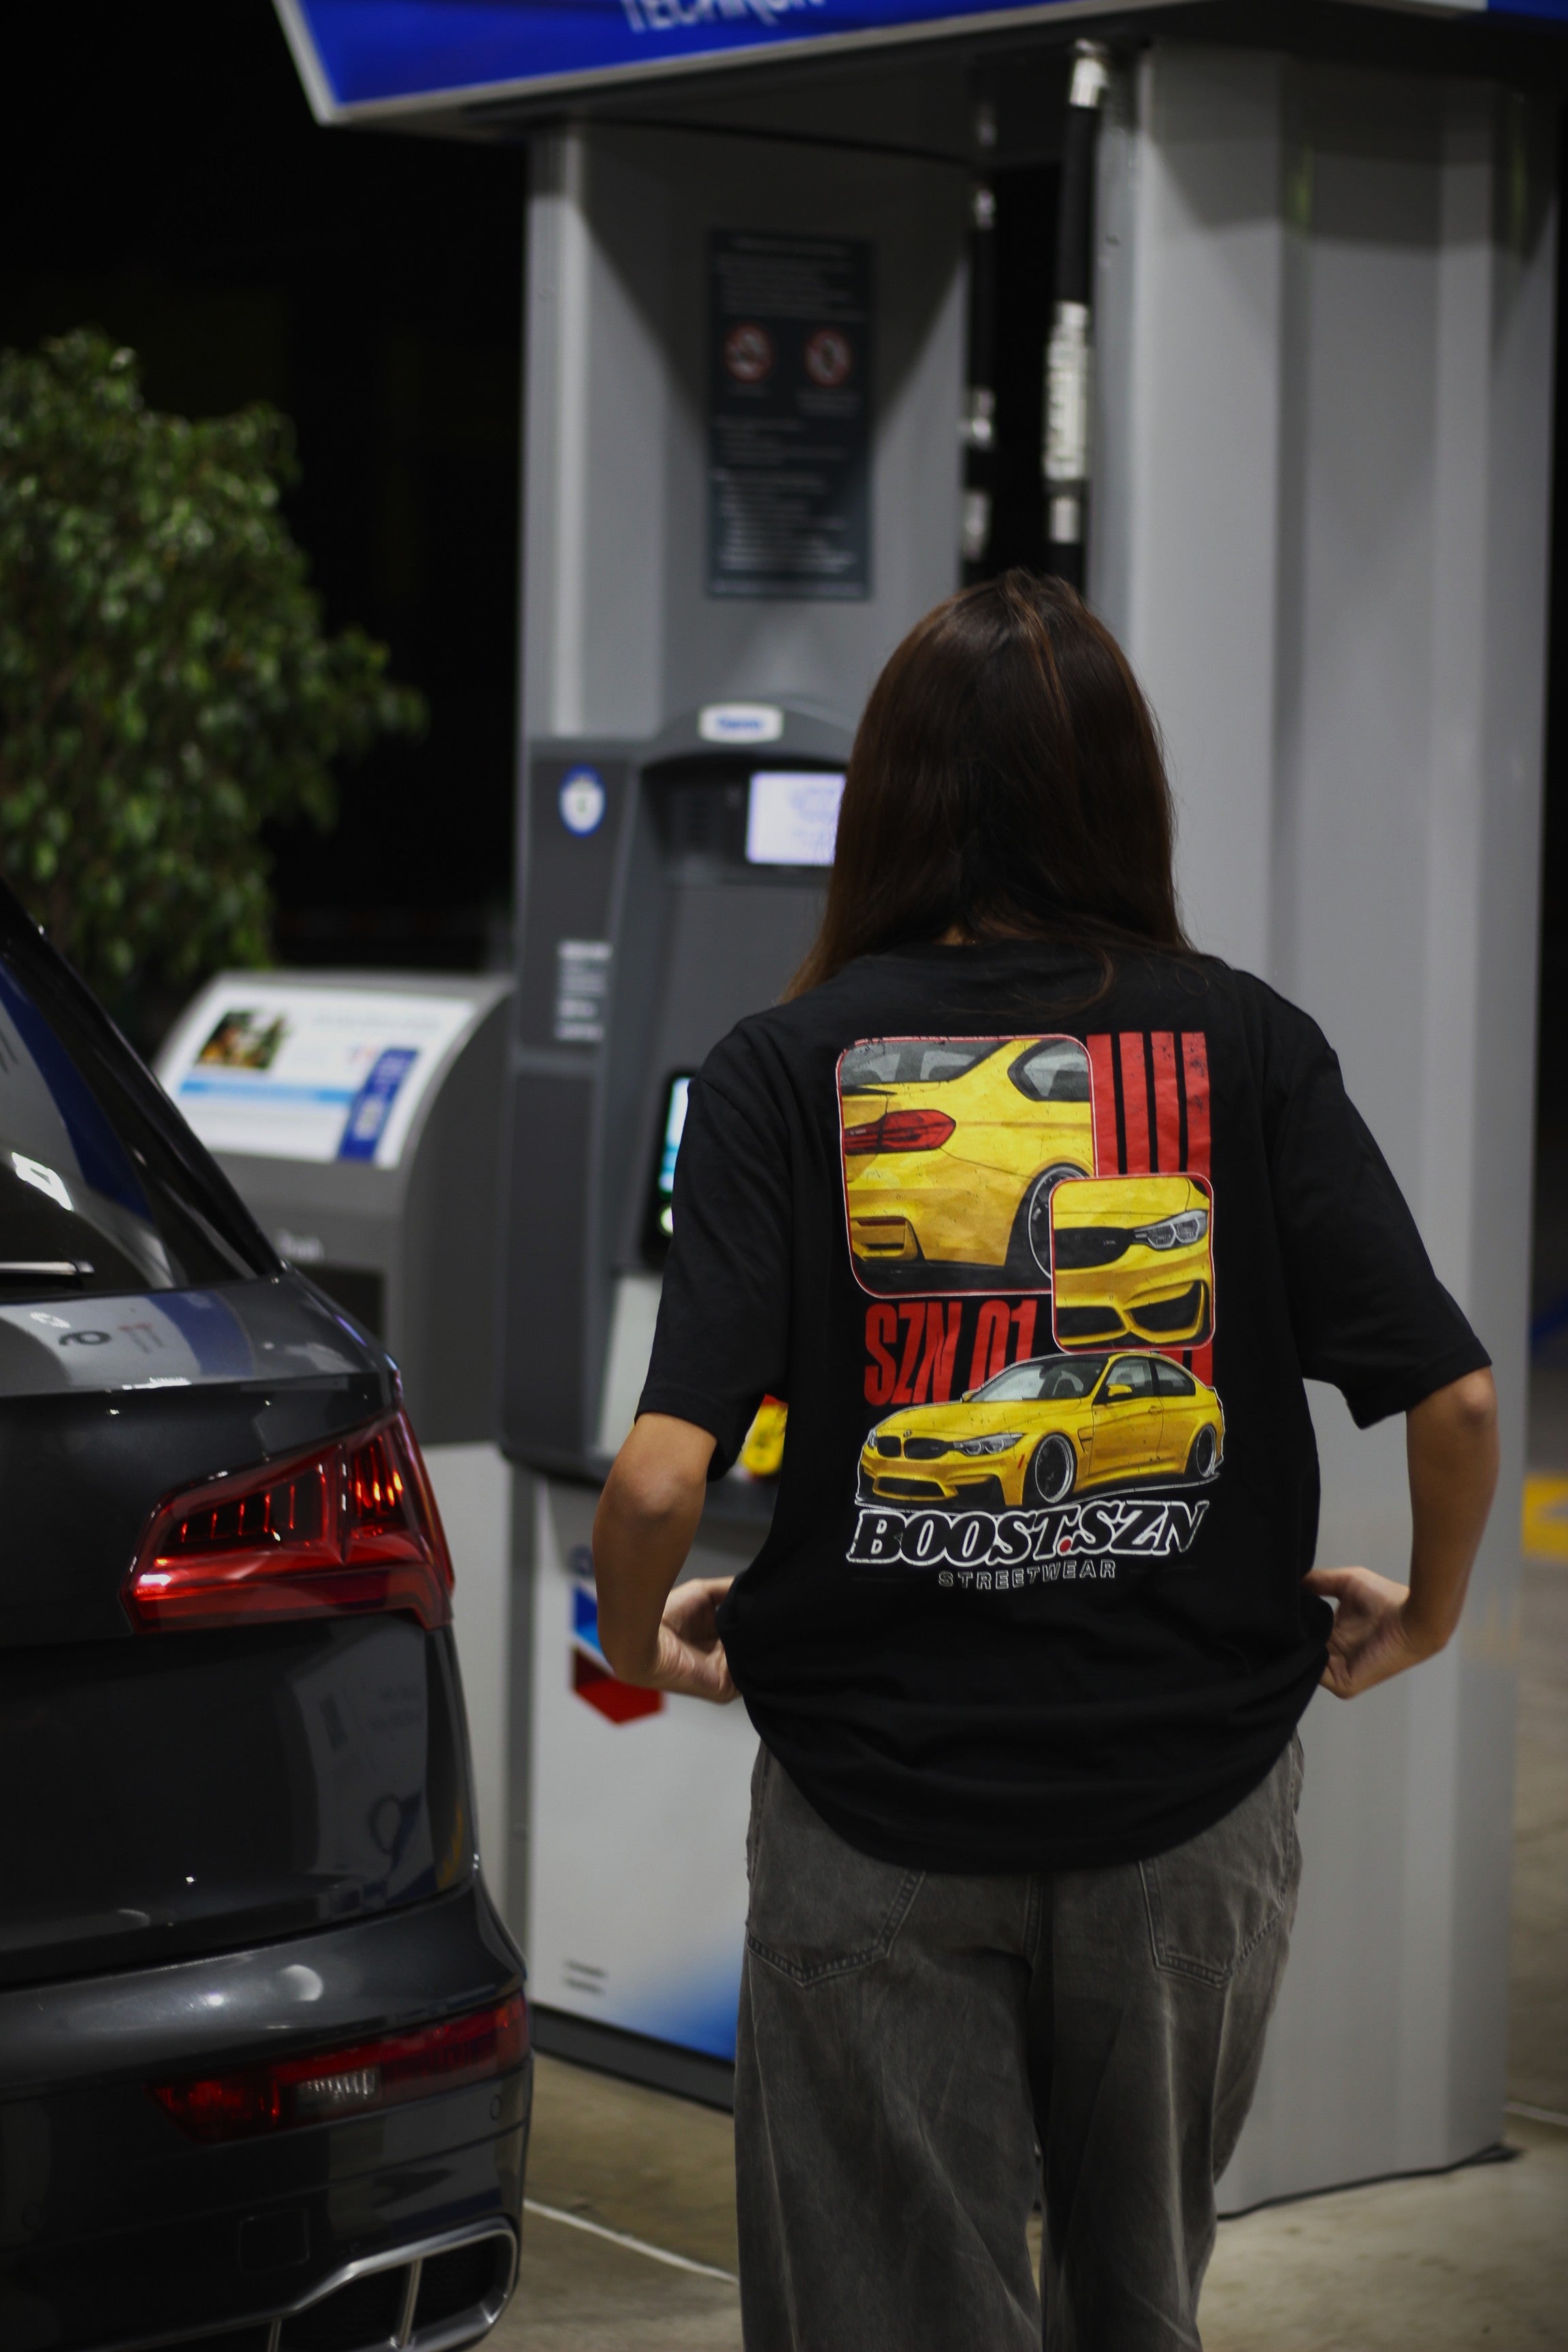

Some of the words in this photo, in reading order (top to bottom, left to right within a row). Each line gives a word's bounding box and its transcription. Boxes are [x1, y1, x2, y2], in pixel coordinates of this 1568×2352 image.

[864, 1300, 962, 1406] SZN
[968, 1298, 1038, 1390] 01
[938, 1558, 1116, 1590] STREETWEAR
